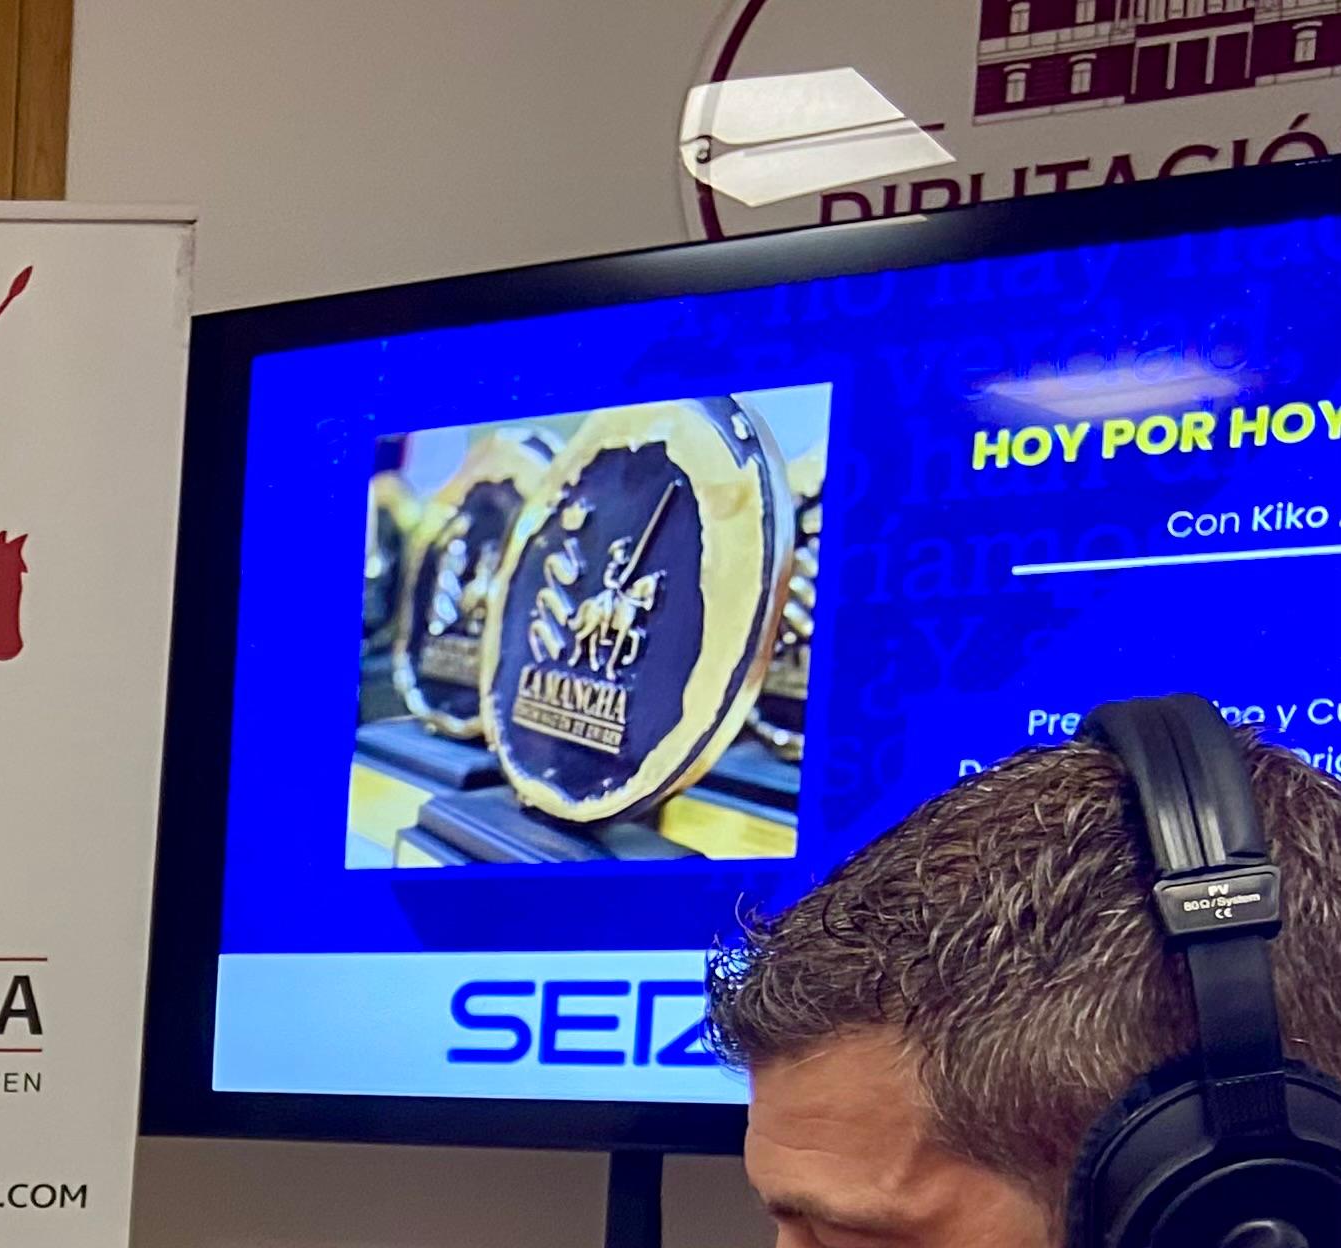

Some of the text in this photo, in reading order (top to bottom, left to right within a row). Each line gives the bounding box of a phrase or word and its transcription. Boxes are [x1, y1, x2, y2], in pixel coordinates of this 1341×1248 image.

[972, 421, 1090, 470] HOY
[1101, 411, 1216, 459] POR
[1229, 400, 1341, 449] HOY
[1167, 502, 1329, 538] Con Kiko
[1276, 703, 1298, 733] y
